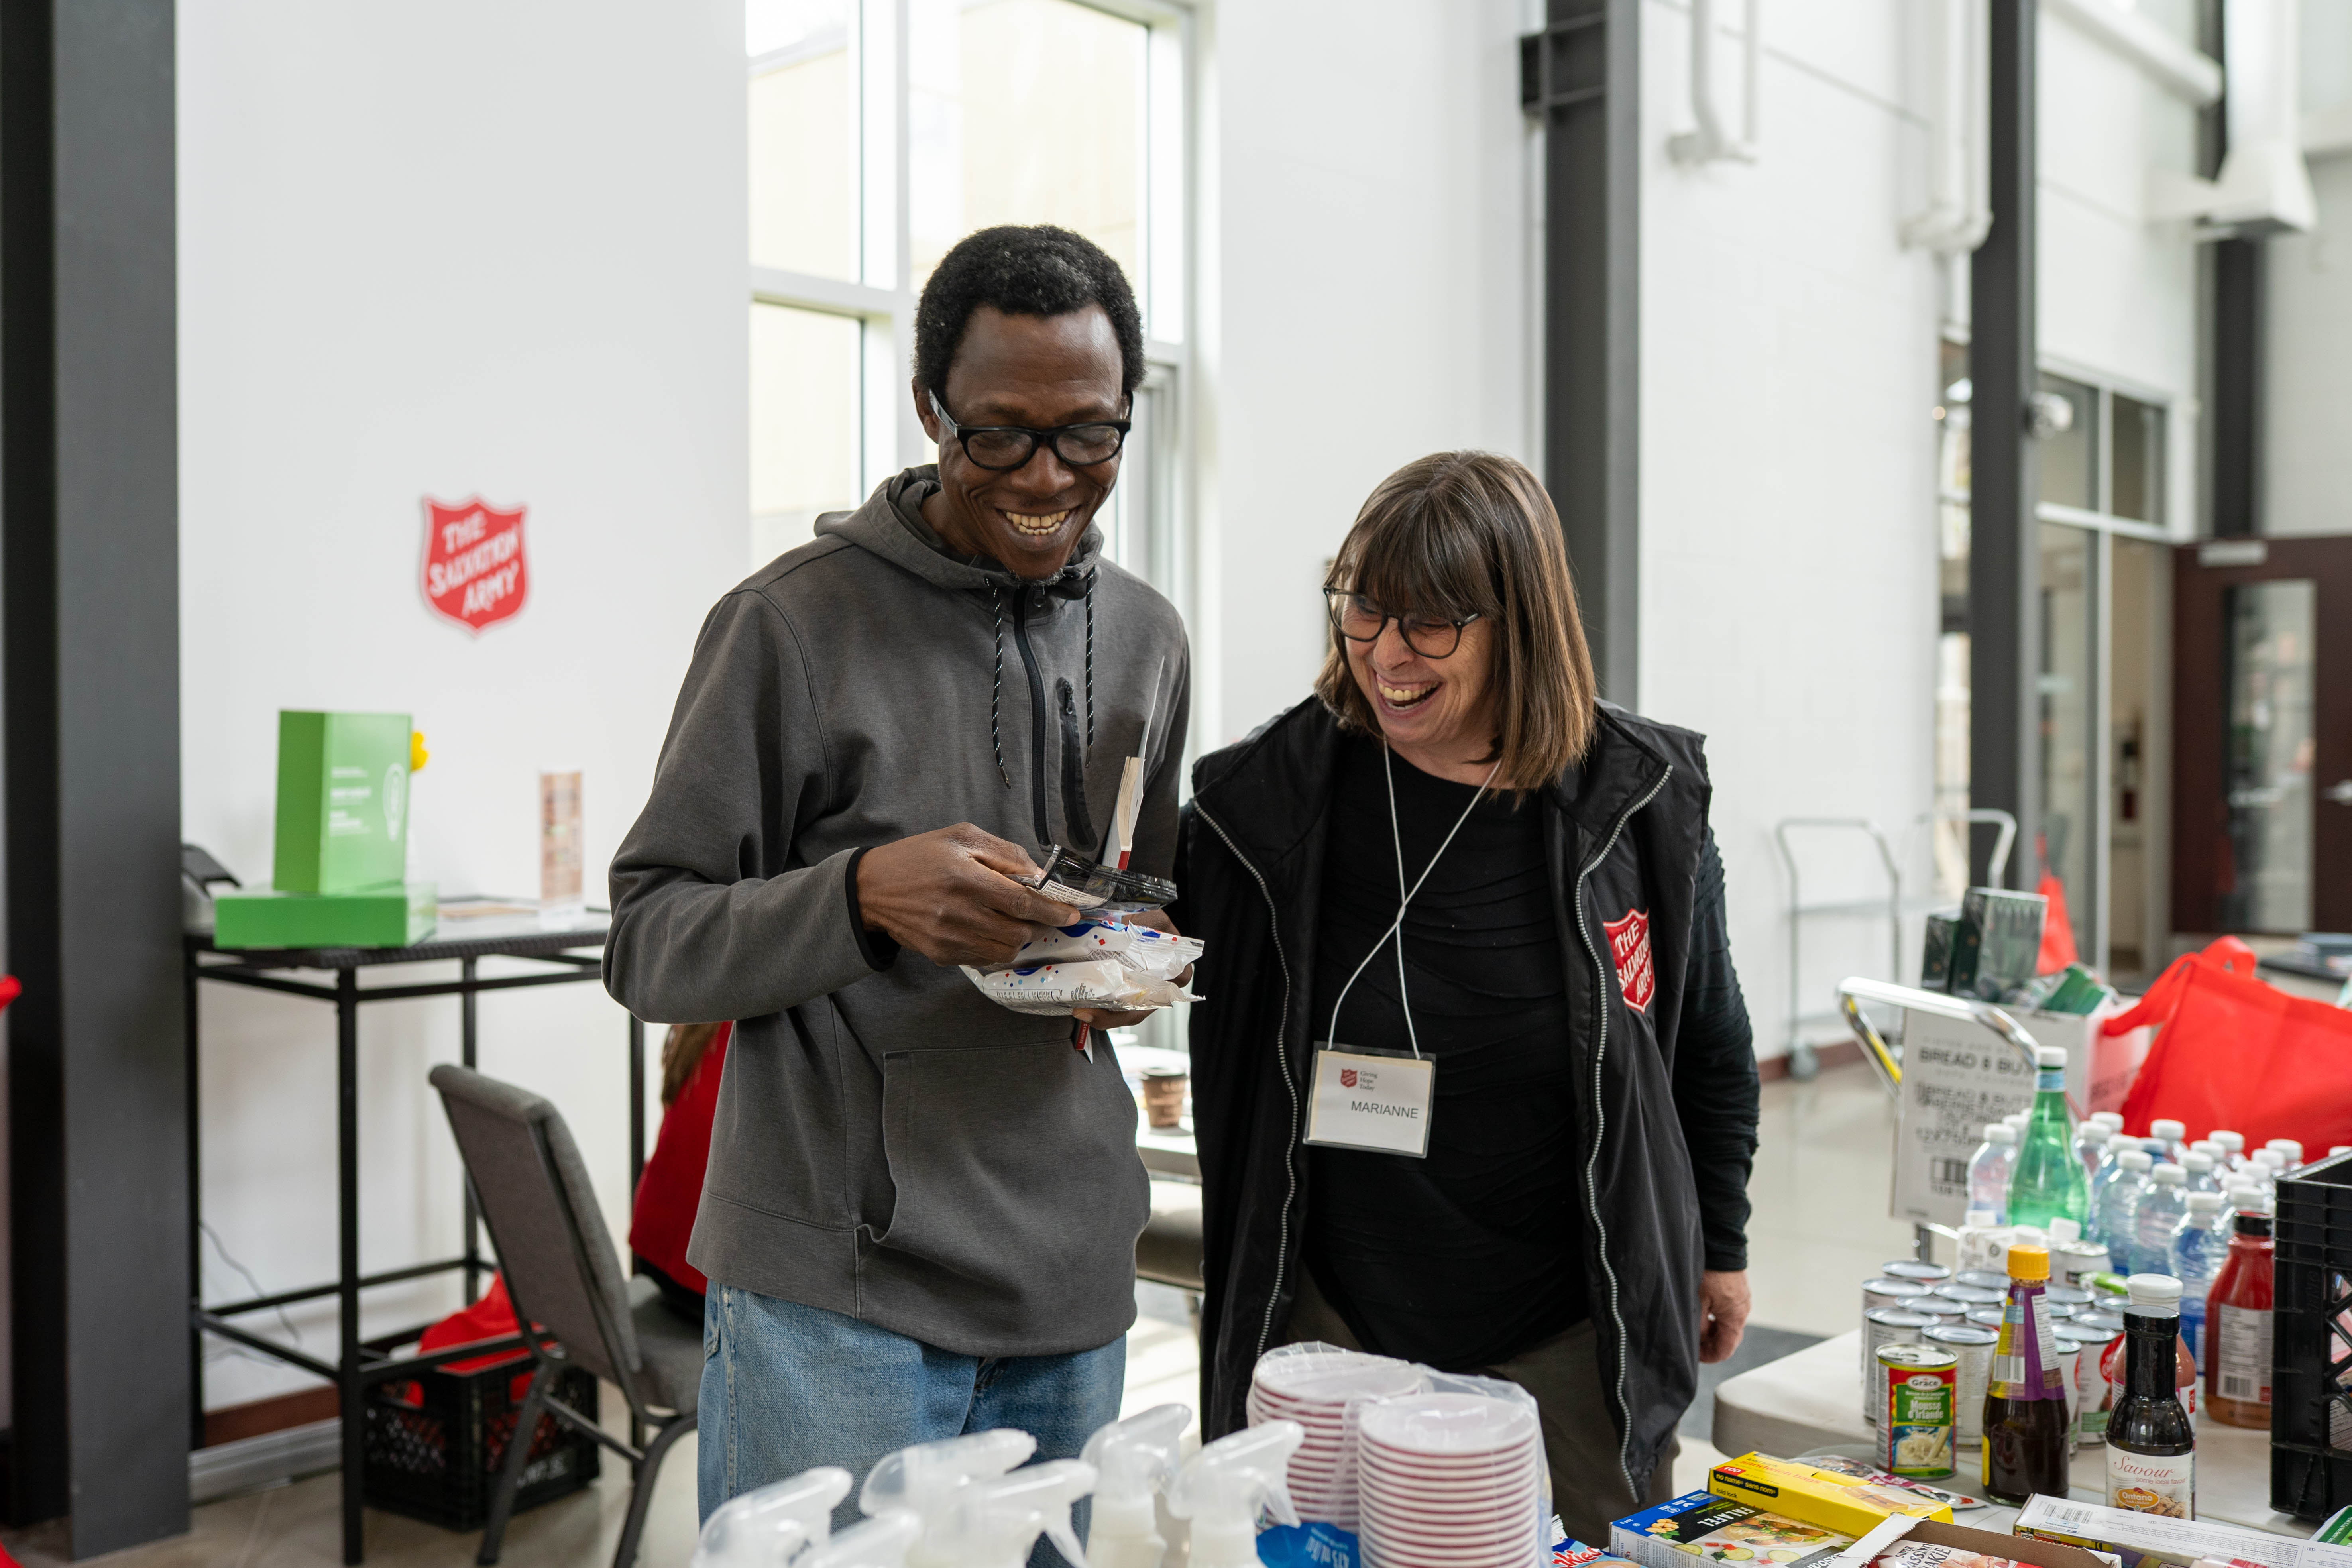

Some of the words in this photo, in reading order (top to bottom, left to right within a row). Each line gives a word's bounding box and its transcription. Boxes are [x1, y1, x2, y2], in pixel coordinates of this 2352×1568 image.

[442, 510, 487, 554] THE
[461, 559, 520, 619] ARMY
[1615, 920, 1639, 957] THE
[1919, 1047, 1977, 1069] BREAD
[1351, 1101, 1419, 1119] MARIANNE
[1740, 1461, 1792, 1476] sandwich
[1793, 1474, 1821, 1484] bags
[2114, 1456, 2172, 1478] Savour
[1745, 1482, 1759, 1490] sans
[2122, 1492, 2153, 1501] Ontario
[1697, 1507, 1756, 1527] FALAFEL
[1895, 1546, 1914, 1558] SUPER
